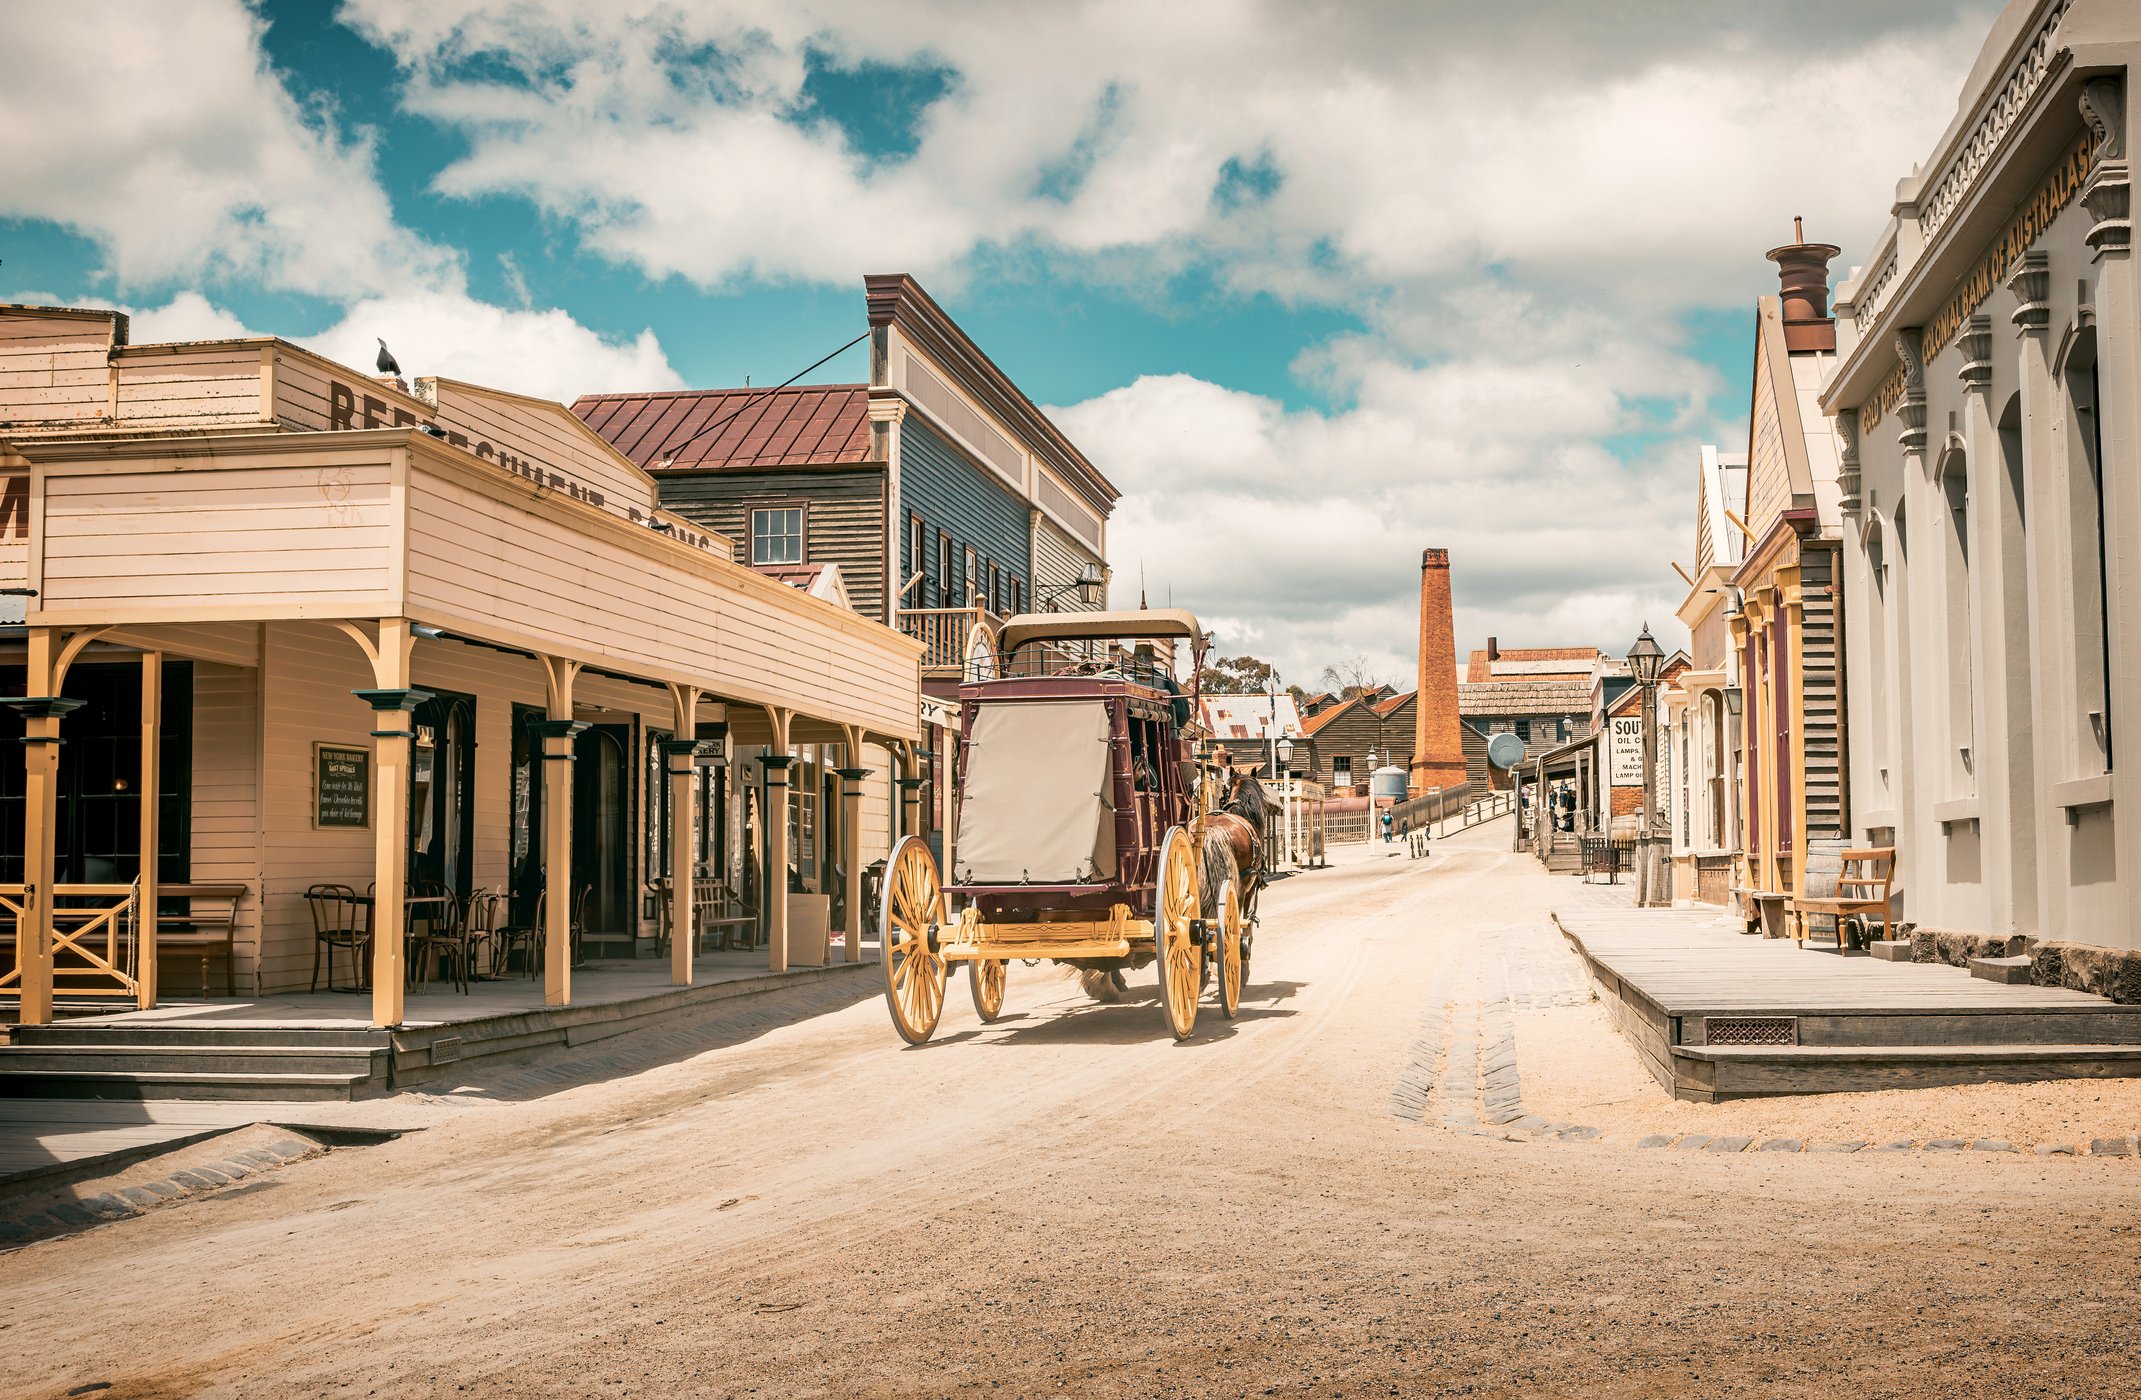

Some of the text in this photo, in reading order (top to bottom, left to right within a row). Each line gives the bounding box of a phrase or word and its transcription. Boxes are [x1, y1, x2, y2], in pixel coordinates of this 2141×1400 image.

[1922, 295, 1961, 367] COLONIAL
[1963, 257, 1991, 320] BANK
[1992, 240, 2005, 283] OF
[1863, 397, 1880, 434] GOLD
[1615, 721, 1641, 735] SOU
[322, 751, 333, 760] NEW
[333, 752, 346, 761] YORK
